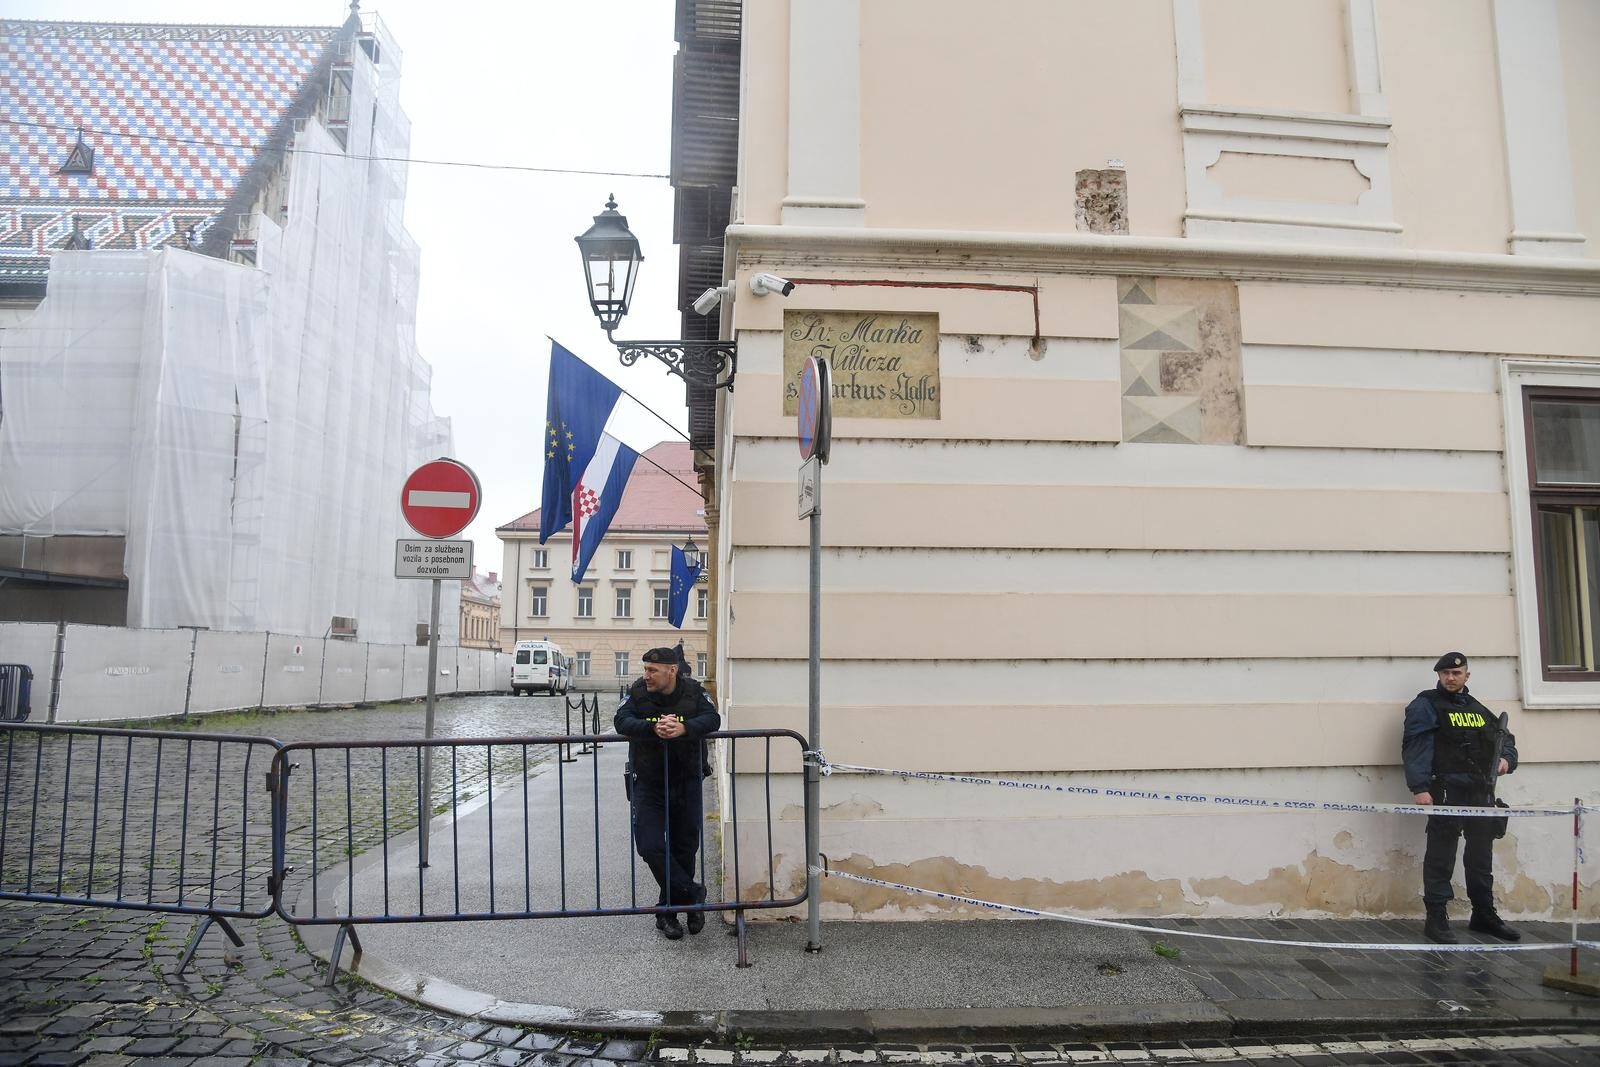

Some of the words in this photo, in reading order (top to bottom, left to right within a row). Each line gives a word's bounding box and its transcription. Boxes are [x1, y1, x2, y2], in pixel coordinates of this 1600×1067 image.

[840, 315, 923, 344] Marka
[831, 372, 886, 400] arkus
[405, 544, 421, 553] Osim
[434, 544, 464, 554] službena
[402, 554, 422, 563] vozila
[431, 555, 465, 565] posebnom
[416, 566, 449, 574] dozvolom
[1448, 712, 1486, 728] POLICIJA
